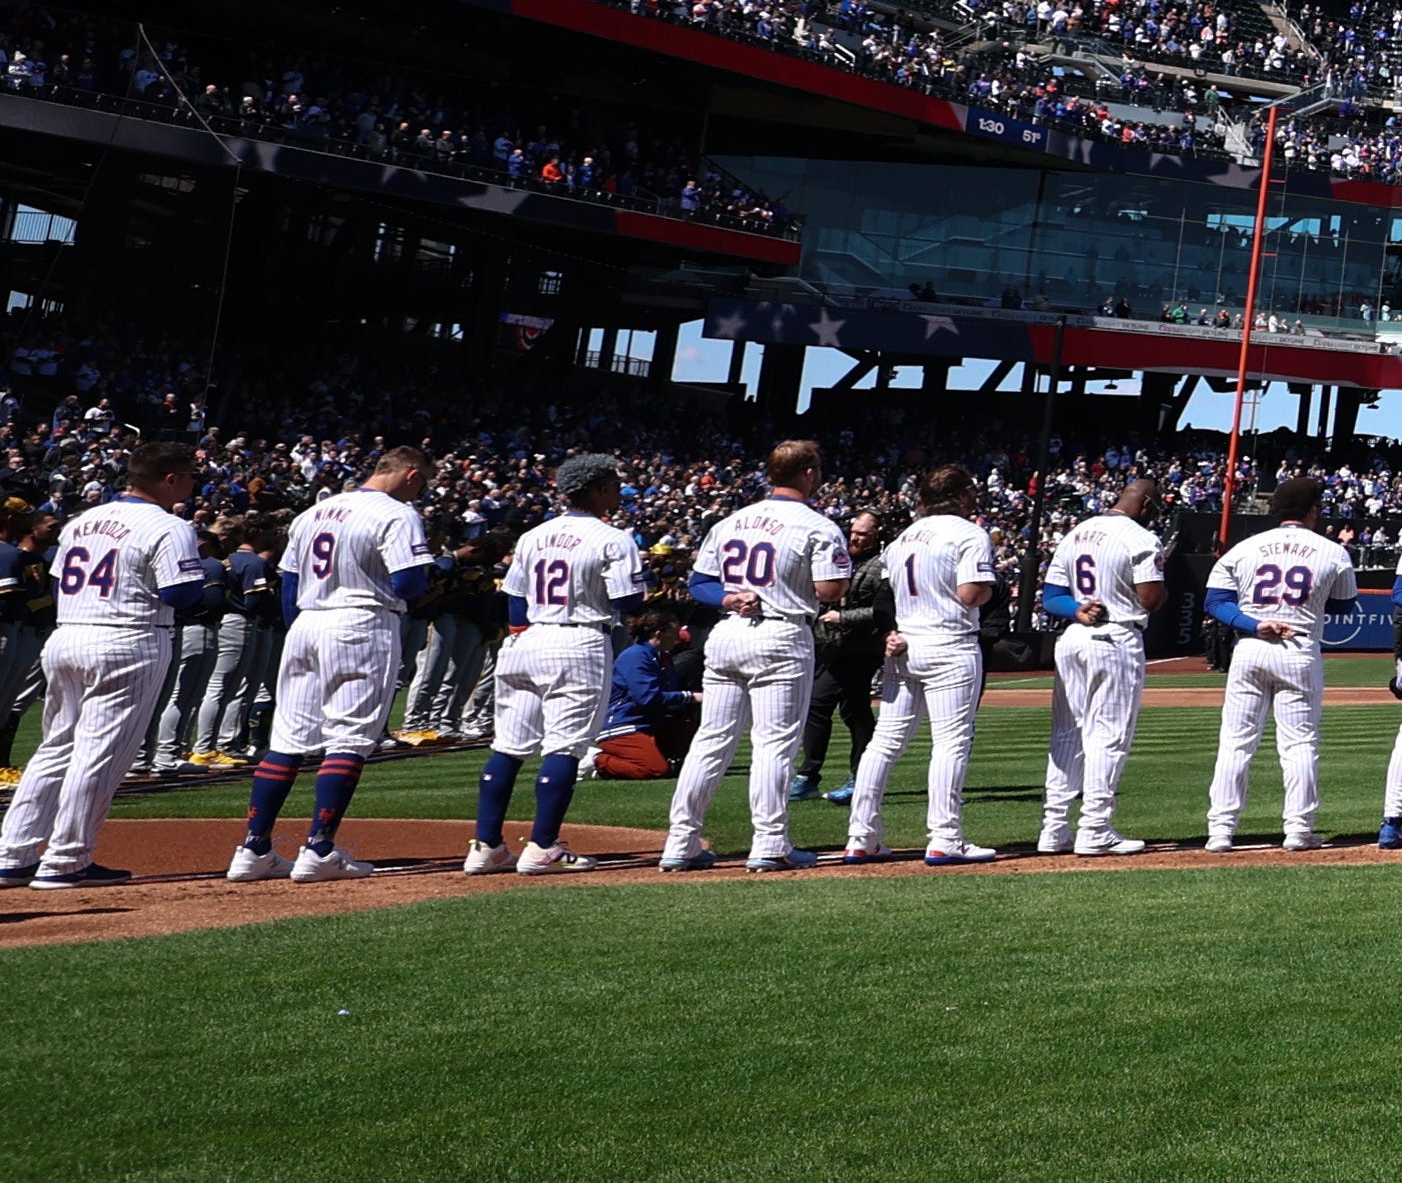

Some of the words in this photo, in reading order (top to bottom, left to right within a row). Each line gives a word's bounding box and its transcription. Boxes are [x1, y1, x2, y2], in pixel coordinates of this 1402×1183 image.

[72, 519, 132, 543] MENDOZA
[536, 533, 582, 552] LINDOR
[734, 516, 784, 536] ALONSO
[1074, 530, 1107, 546] MARTE
[312, 532, 335, 580] 9
[722, 539, 776, 587] 20
[1259, 541, 1319, 559] STEWART
[60, 546, 120, 598] 64
[534, 558, 569, 606] 12
[904, 553, 918, 597] 1
[1075, 554, 1096, 595] 6
[1253, 563, 1314, 607] 29
